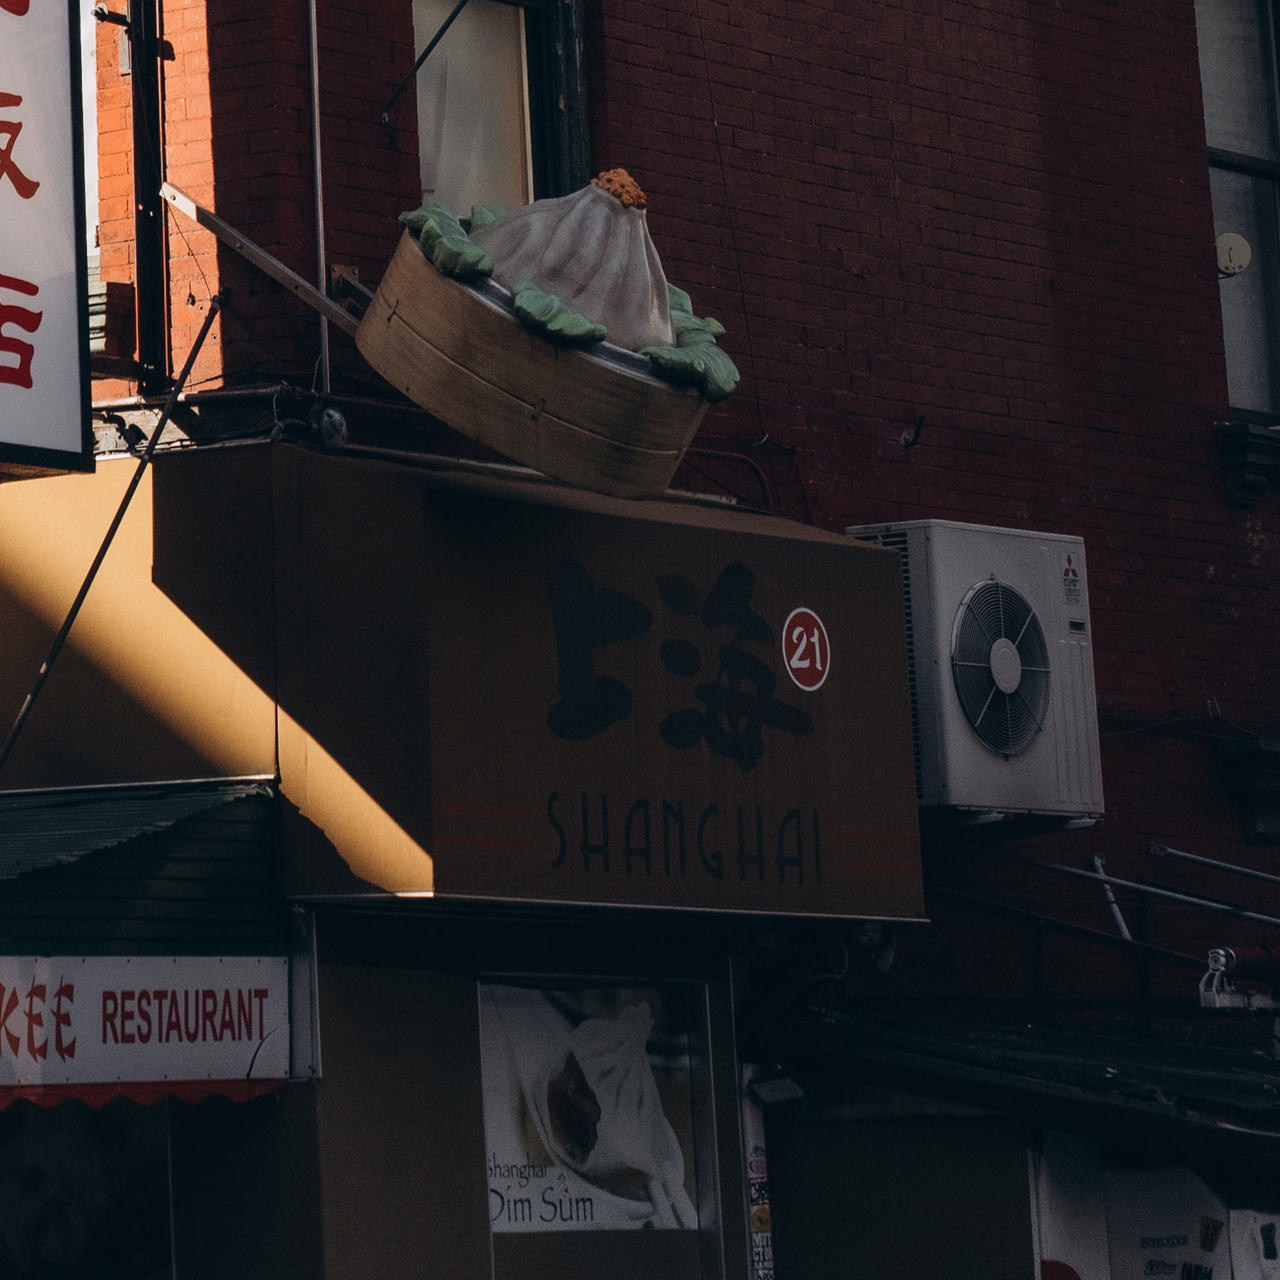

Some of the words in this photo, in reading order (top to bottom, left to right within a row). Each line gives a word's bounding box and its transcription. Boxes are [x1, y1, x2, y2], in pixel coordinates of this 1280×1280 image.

[789, 626, 824, 672] 21
[547, 790, 823, 885] SHANGHAI
[102, 988, 269, 1045] RESTAURANT
[540, 1186, 594, 1223] Sum
